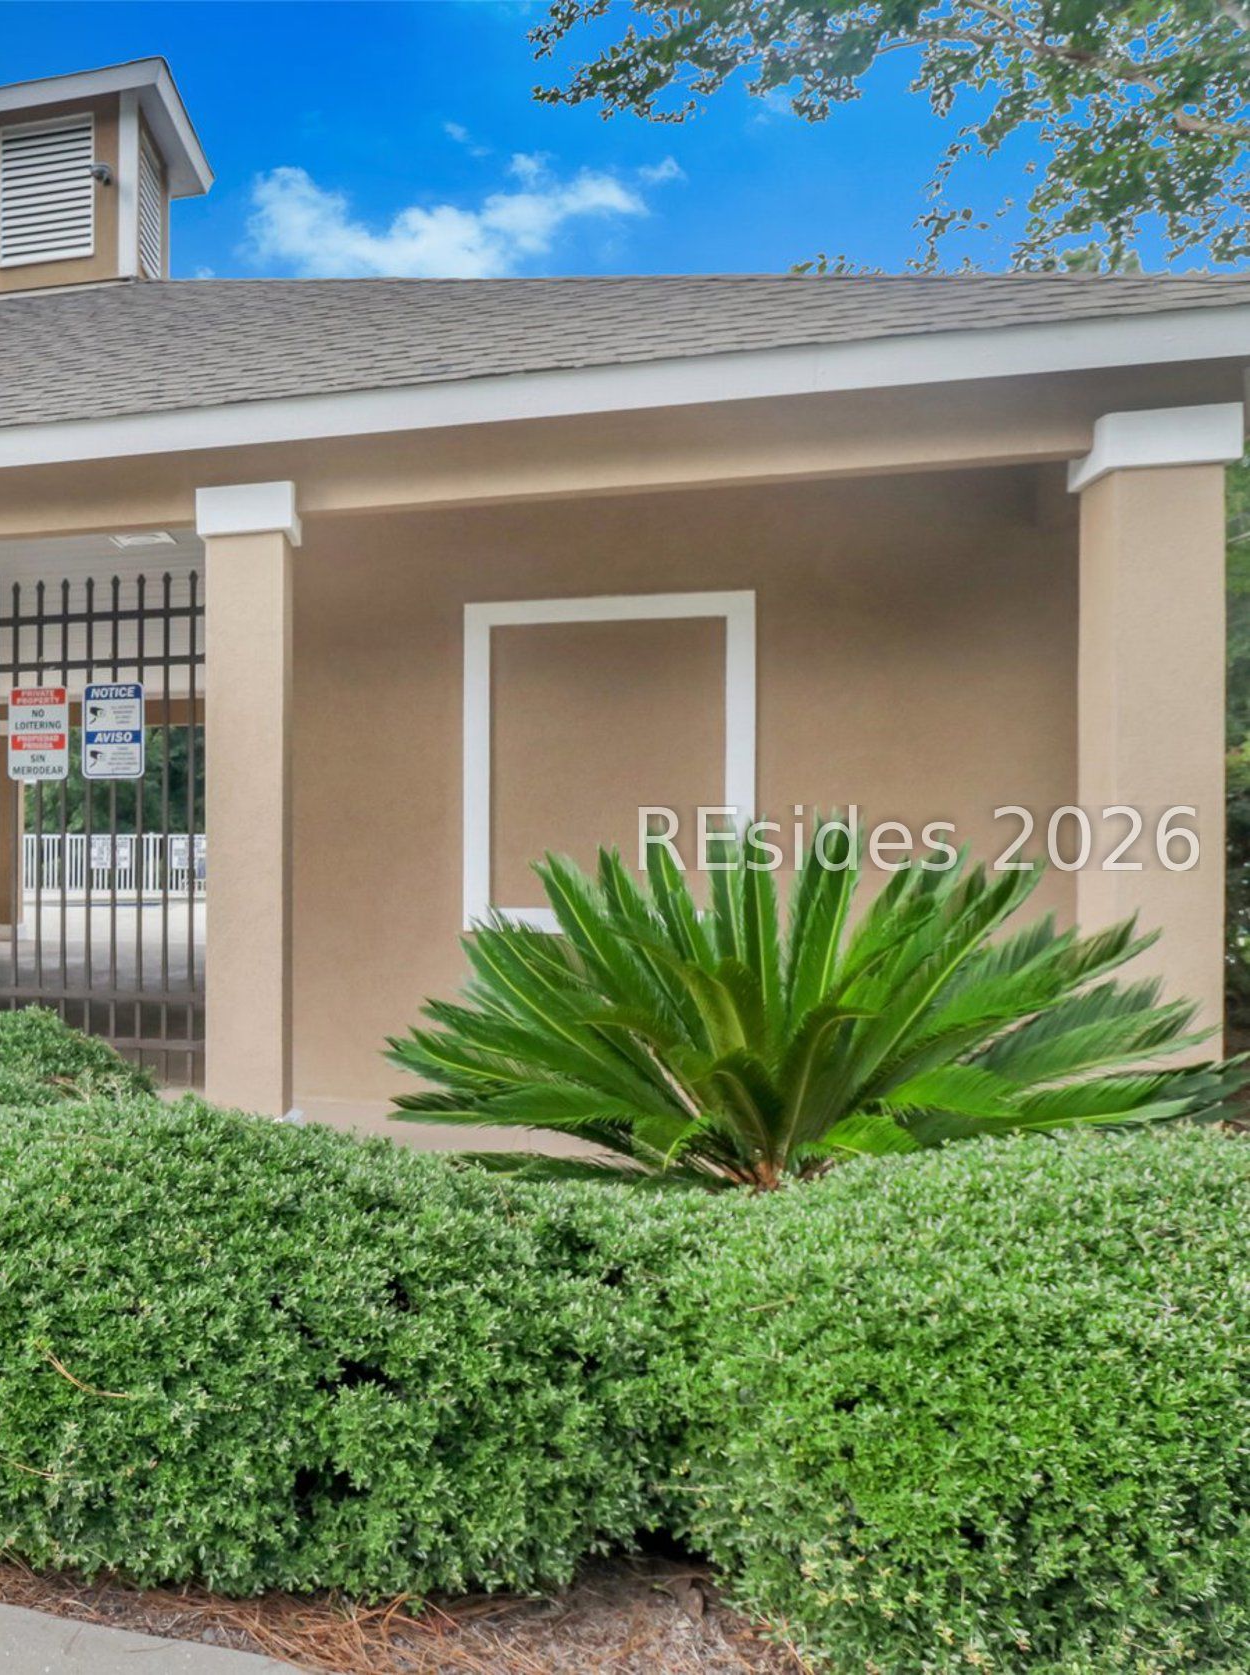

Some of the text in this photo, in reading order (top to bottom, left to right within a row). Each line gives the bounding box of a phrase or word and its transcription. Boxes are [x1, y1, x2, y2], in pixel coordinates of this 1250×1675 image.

[91, 687, 135, 698] NOTICE
[31, 709, 45, 718] NO
[15, 721, 62, 730] LOITERING
[94, 732, 133, 743] AVISO
[30, 754, 46, 763] SIN
[12, 766, 64, 775] MERODEAR
